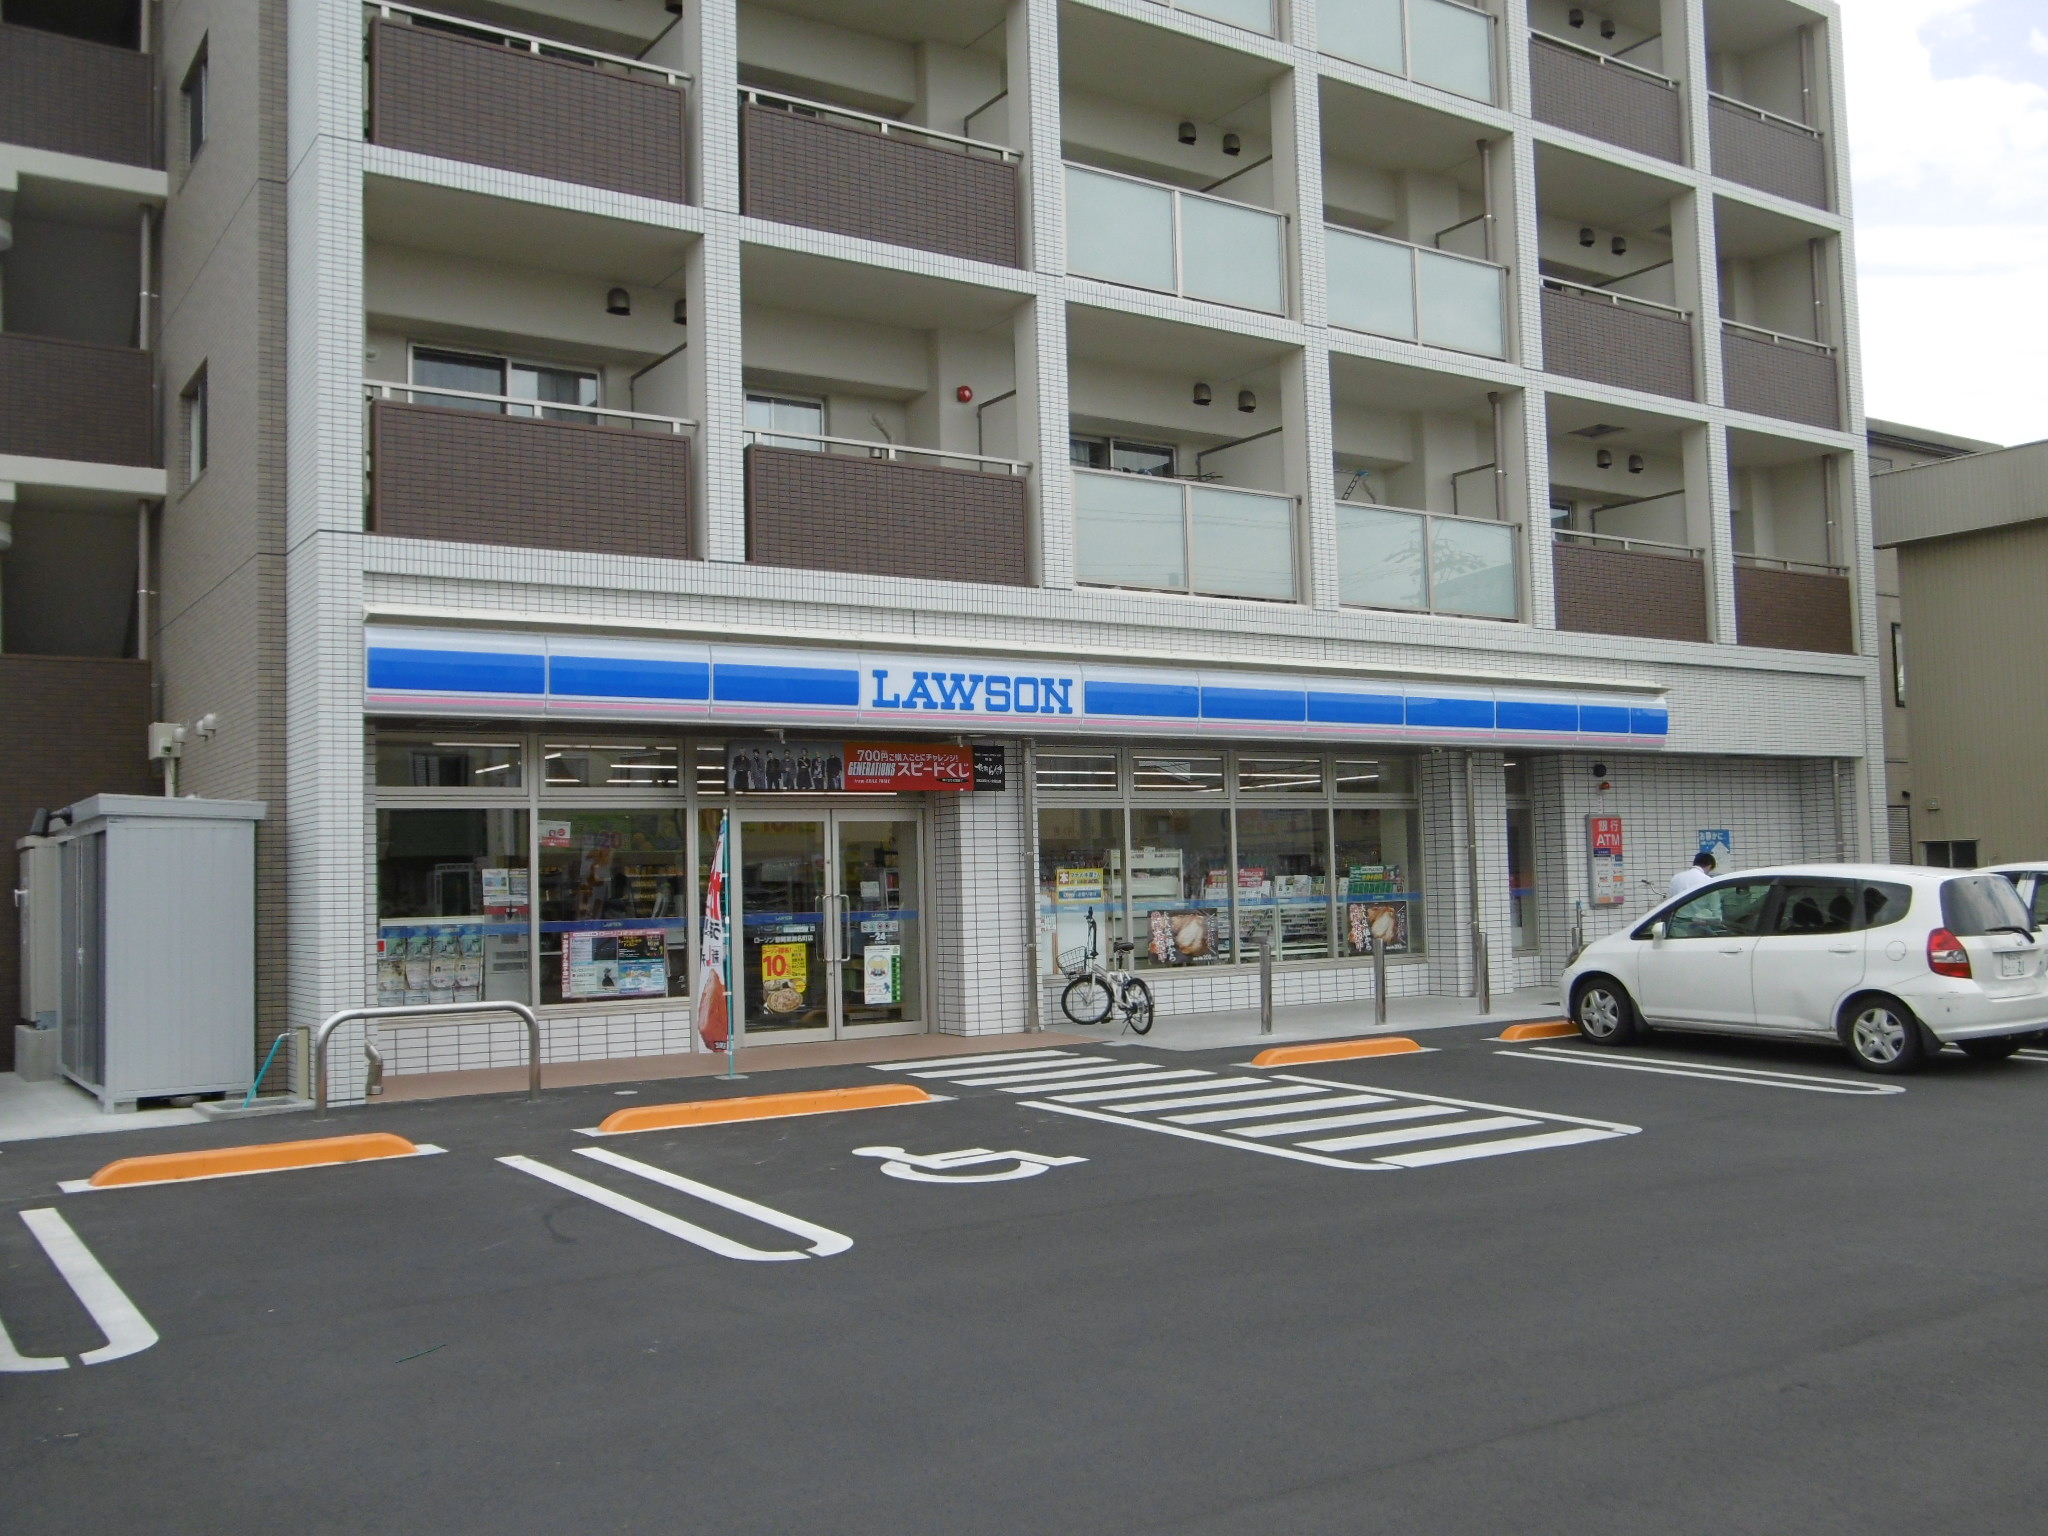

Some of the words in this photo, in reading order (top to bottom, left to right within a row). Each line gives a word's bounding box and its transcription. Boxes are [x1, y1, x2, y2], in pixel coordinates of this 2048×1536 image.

[872, 669, 1073, 714] LAWSON
[847, 761, 897, 776] GENERATIONS
[897, 762, 970, 778] スピードくじ
[1598, 820, 1619, 833] 銀行
[1596, 833, 1621, 847] ATM
[1059, 871, 1069, 884] 本
[874, 932, 887, 941] 24
[763, 954, 786, 977] 10
